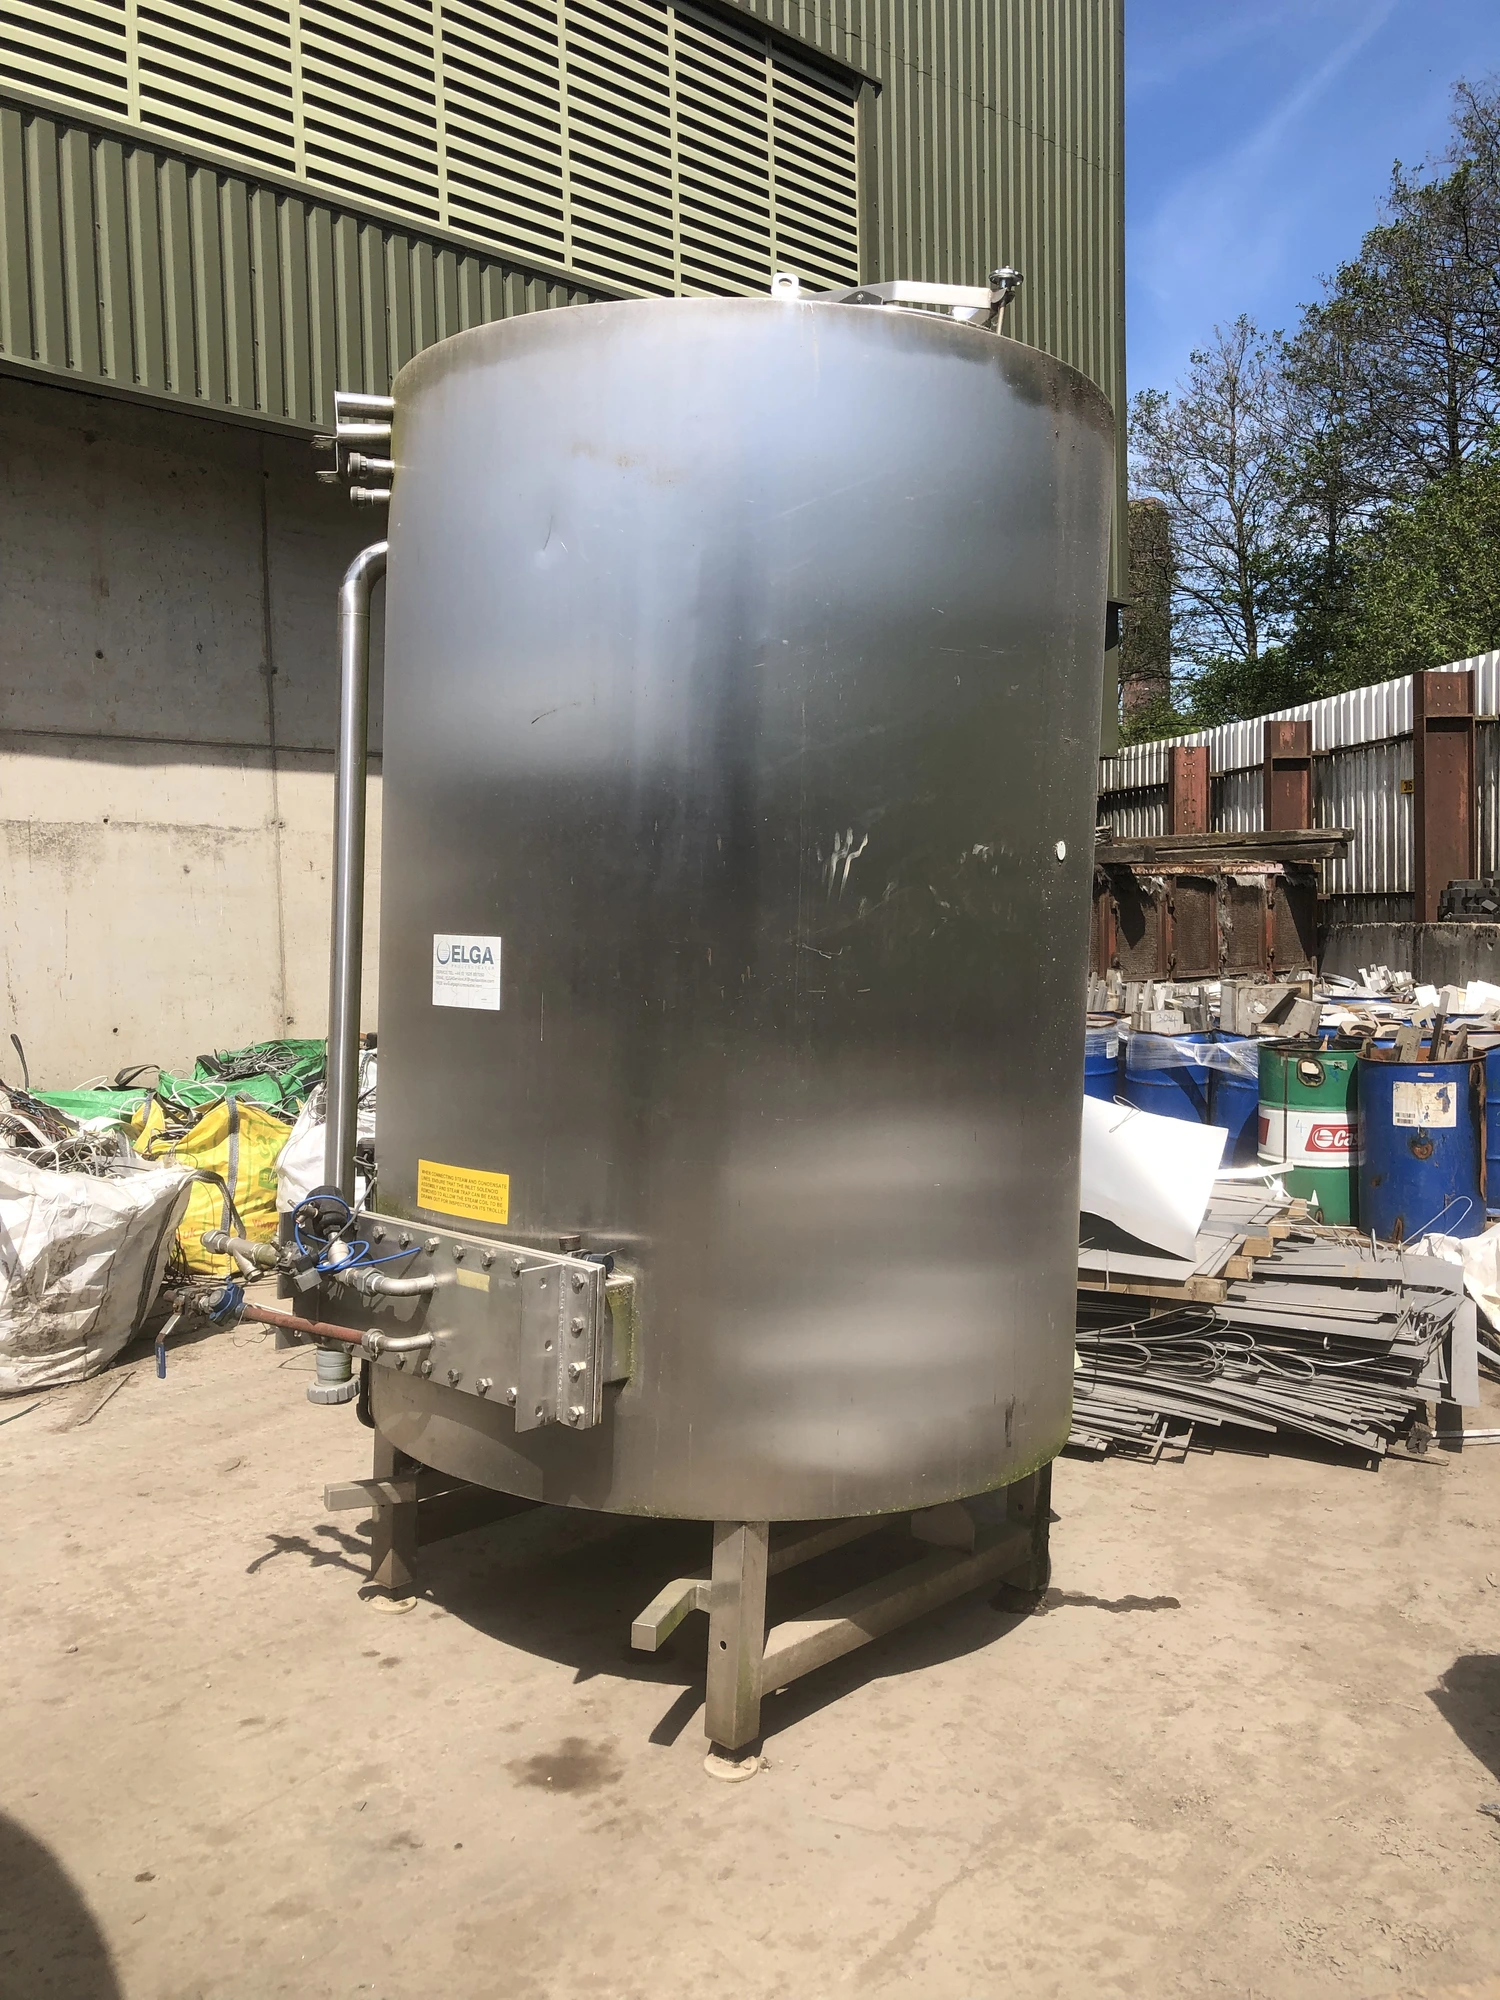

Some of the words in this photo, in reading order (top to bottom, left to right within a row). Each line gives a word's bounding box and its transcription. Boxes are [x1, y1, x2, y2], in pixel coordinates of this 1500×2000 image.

[451, 945, 494, 964] ELGA
[432, 1171, 454, 1179] CONNECTING
[478, 1180, 507, 1190] CONDENSATE
[449, 1200, 471, 1209] INSPECTION
[487, 1207, 507, 1215] TROLLEY
